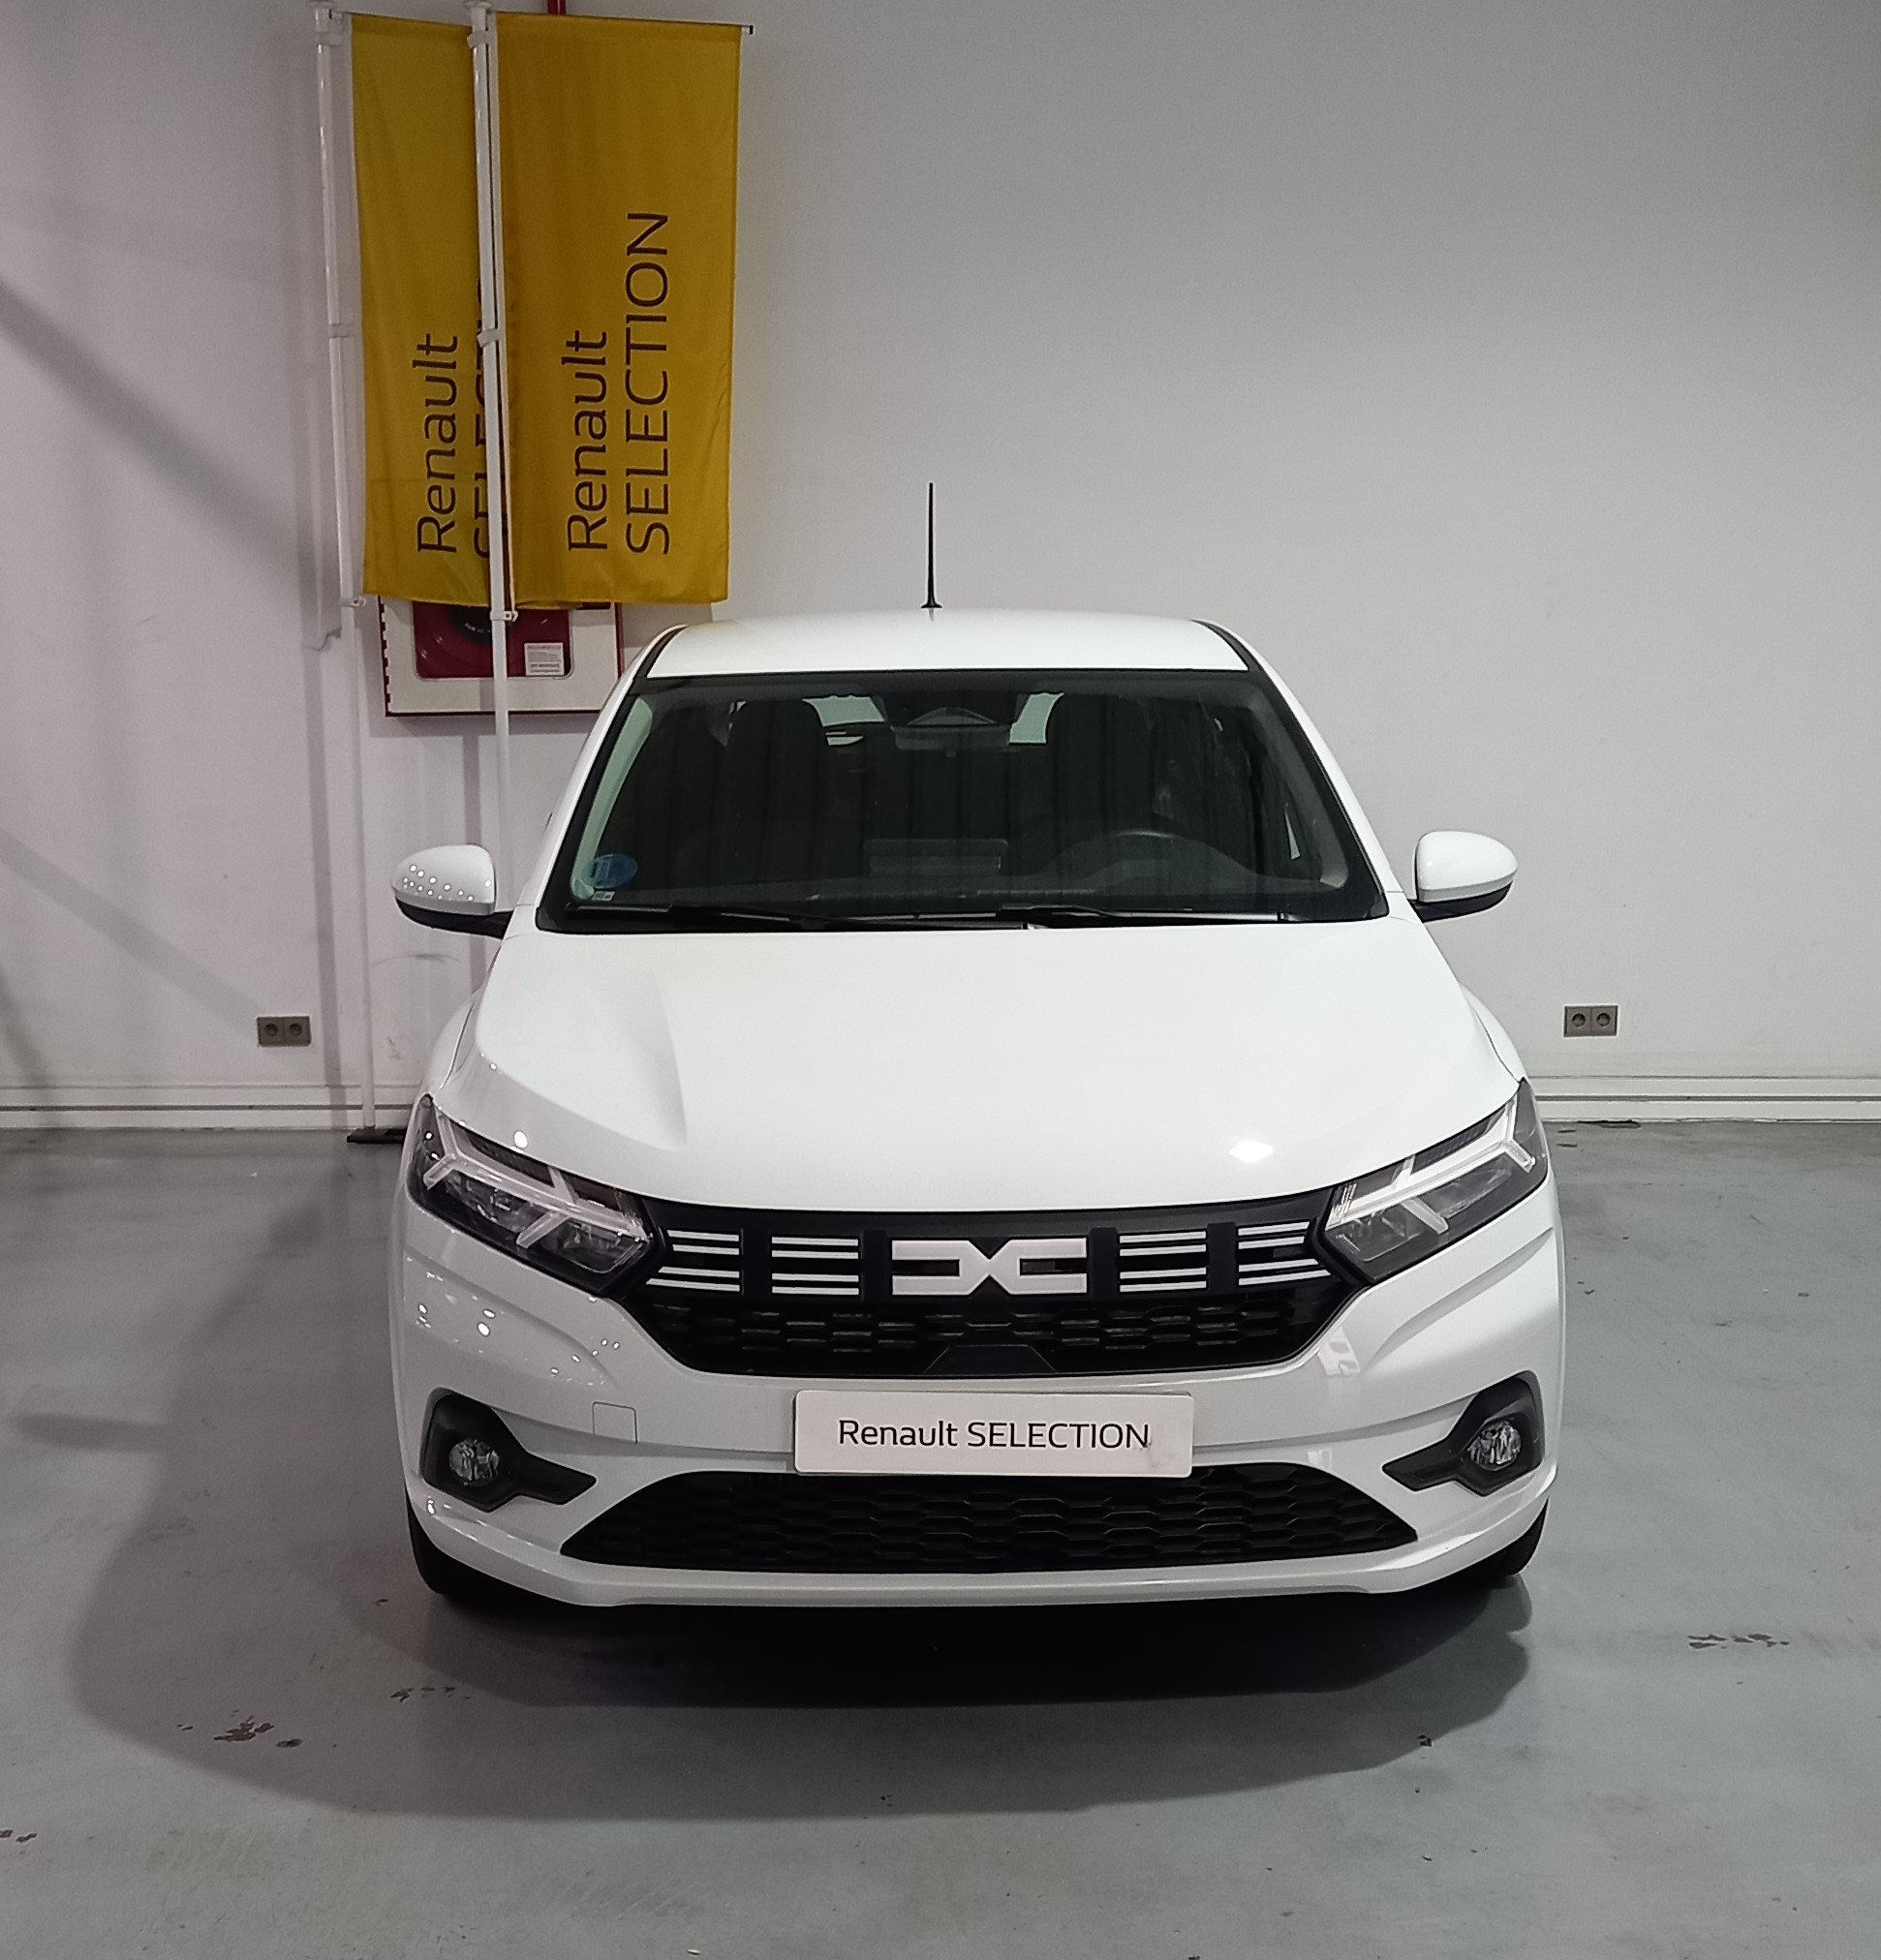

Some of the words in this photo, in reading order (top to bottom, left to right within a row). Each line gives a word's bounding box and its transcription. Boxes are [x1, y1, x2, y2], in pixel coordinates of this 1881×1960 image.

[412, 332, 458, 554] Renault
[560, 329, 608, 552] Renault
[625, 212, 670, 555] SELECTION
[838, 1419, 959, 1447] Renault
[967, 1422, 1149, 1449] SELECTION
